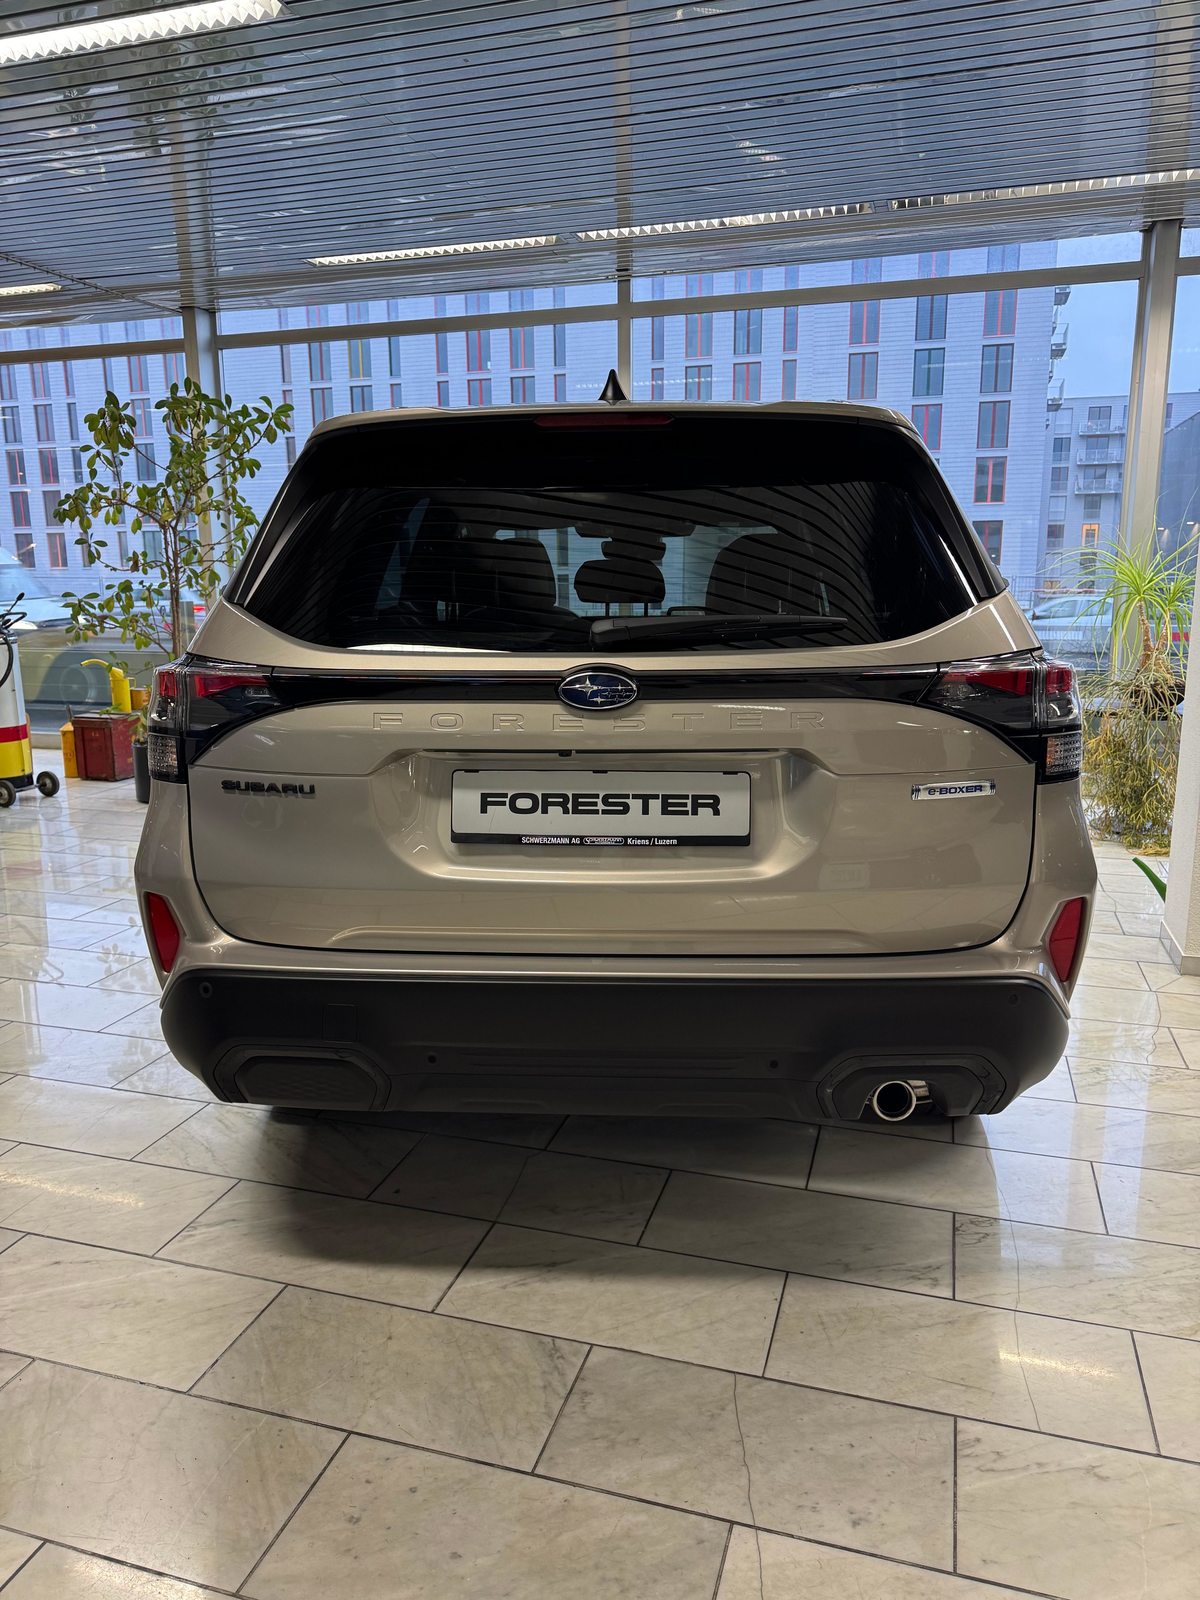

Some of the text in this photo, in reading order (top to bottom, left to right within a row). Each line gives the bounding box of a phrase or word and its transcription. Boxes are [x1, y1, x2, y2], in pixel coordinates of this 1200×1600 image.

[372, 711, 826, 732] FORESTER
[221, 780, 316, 795] SUBARU
[928, 784, 983, 796] e-BOXER
[480, 792, 721, 816] FORESTER
[521, 836, 570, 845] SCHWERZMANN
[571, 837, 581, 845] AG
[627, 837, 650, 845] Kriens
[654, 837, 678, 846] Luzern
